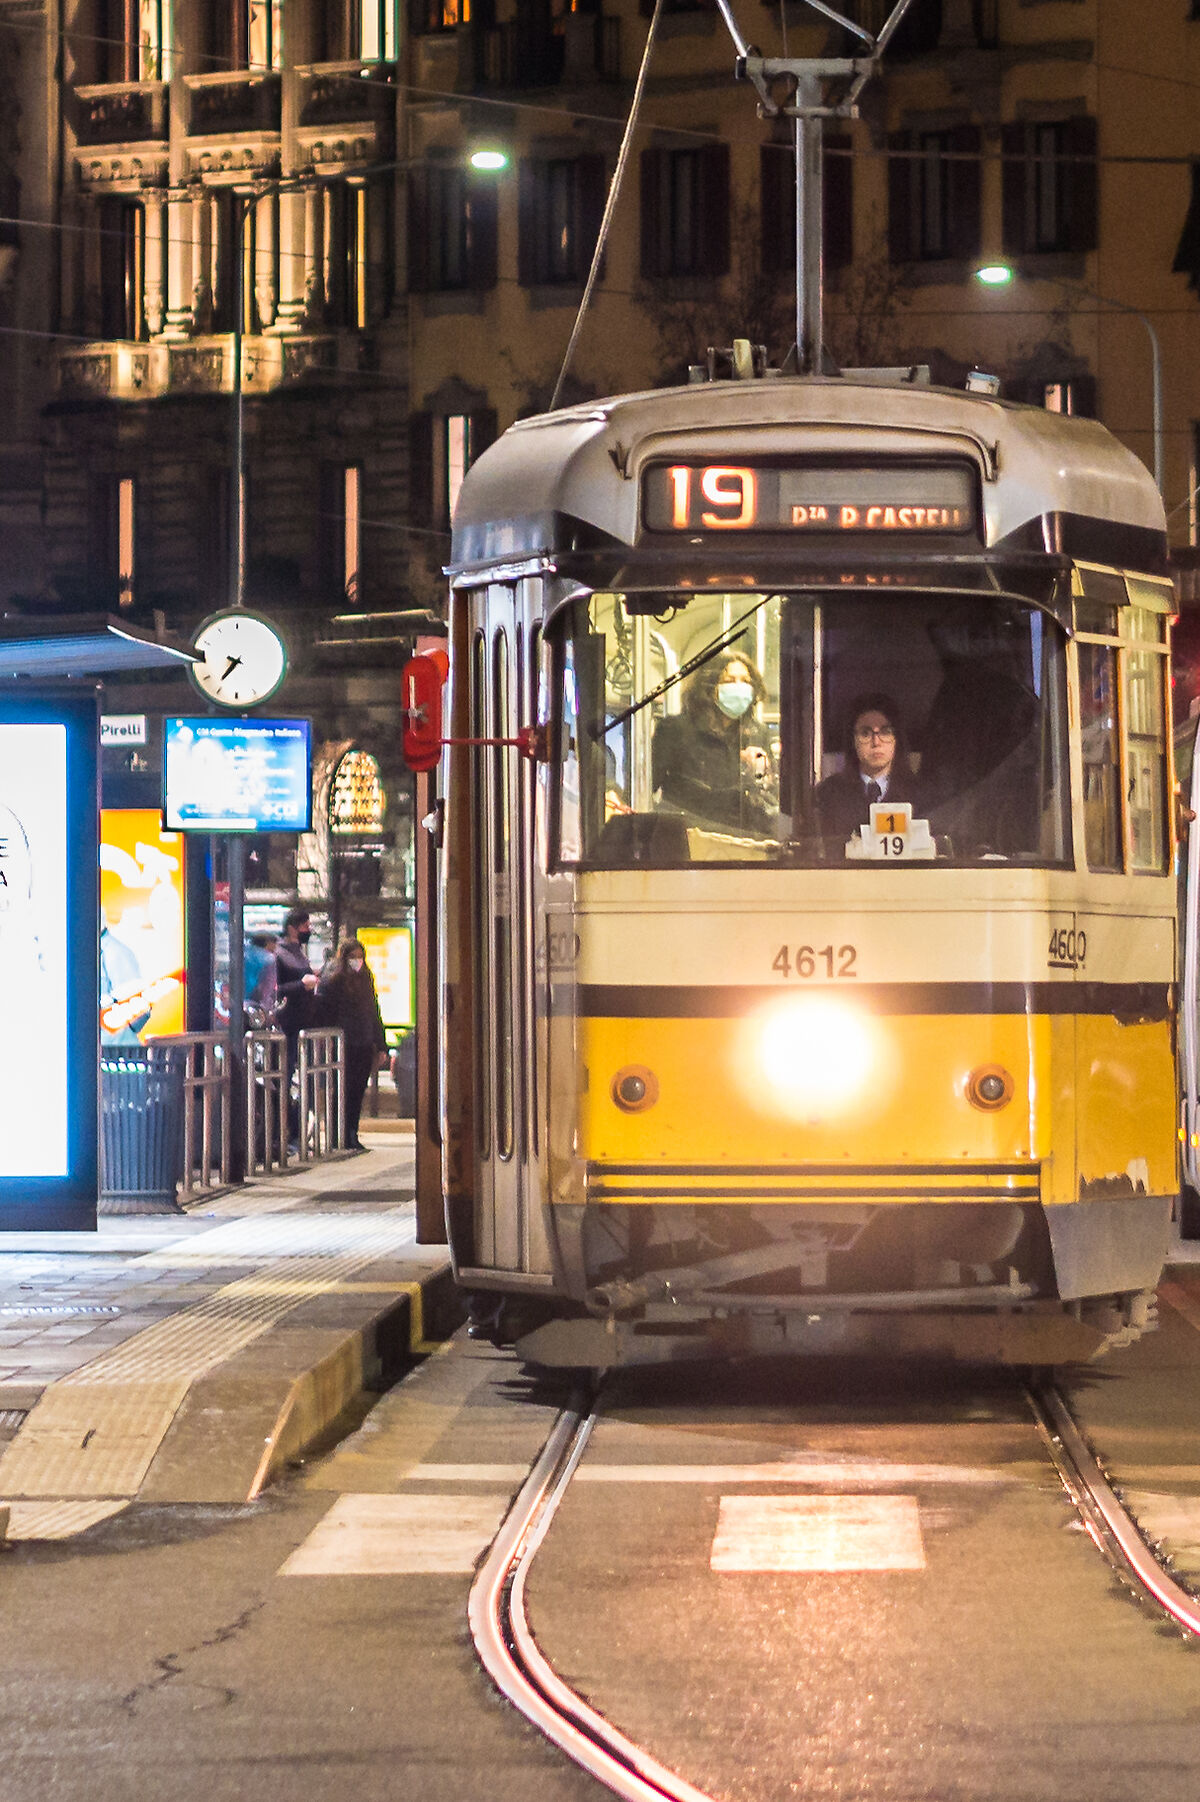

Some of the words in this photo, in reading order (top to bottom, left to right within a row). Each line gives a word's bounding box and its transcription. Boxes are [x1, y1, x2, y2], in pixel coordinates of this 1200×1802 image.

[670, 465, 756, 530] 19
[101, 724, 141, 737] Pirelli
[886, 814, 896, 833] 1
[880, 836, 905, 856] 19
[1048, 928, 1087, 962] 4600
[772, 944, 857, 978] 4612
